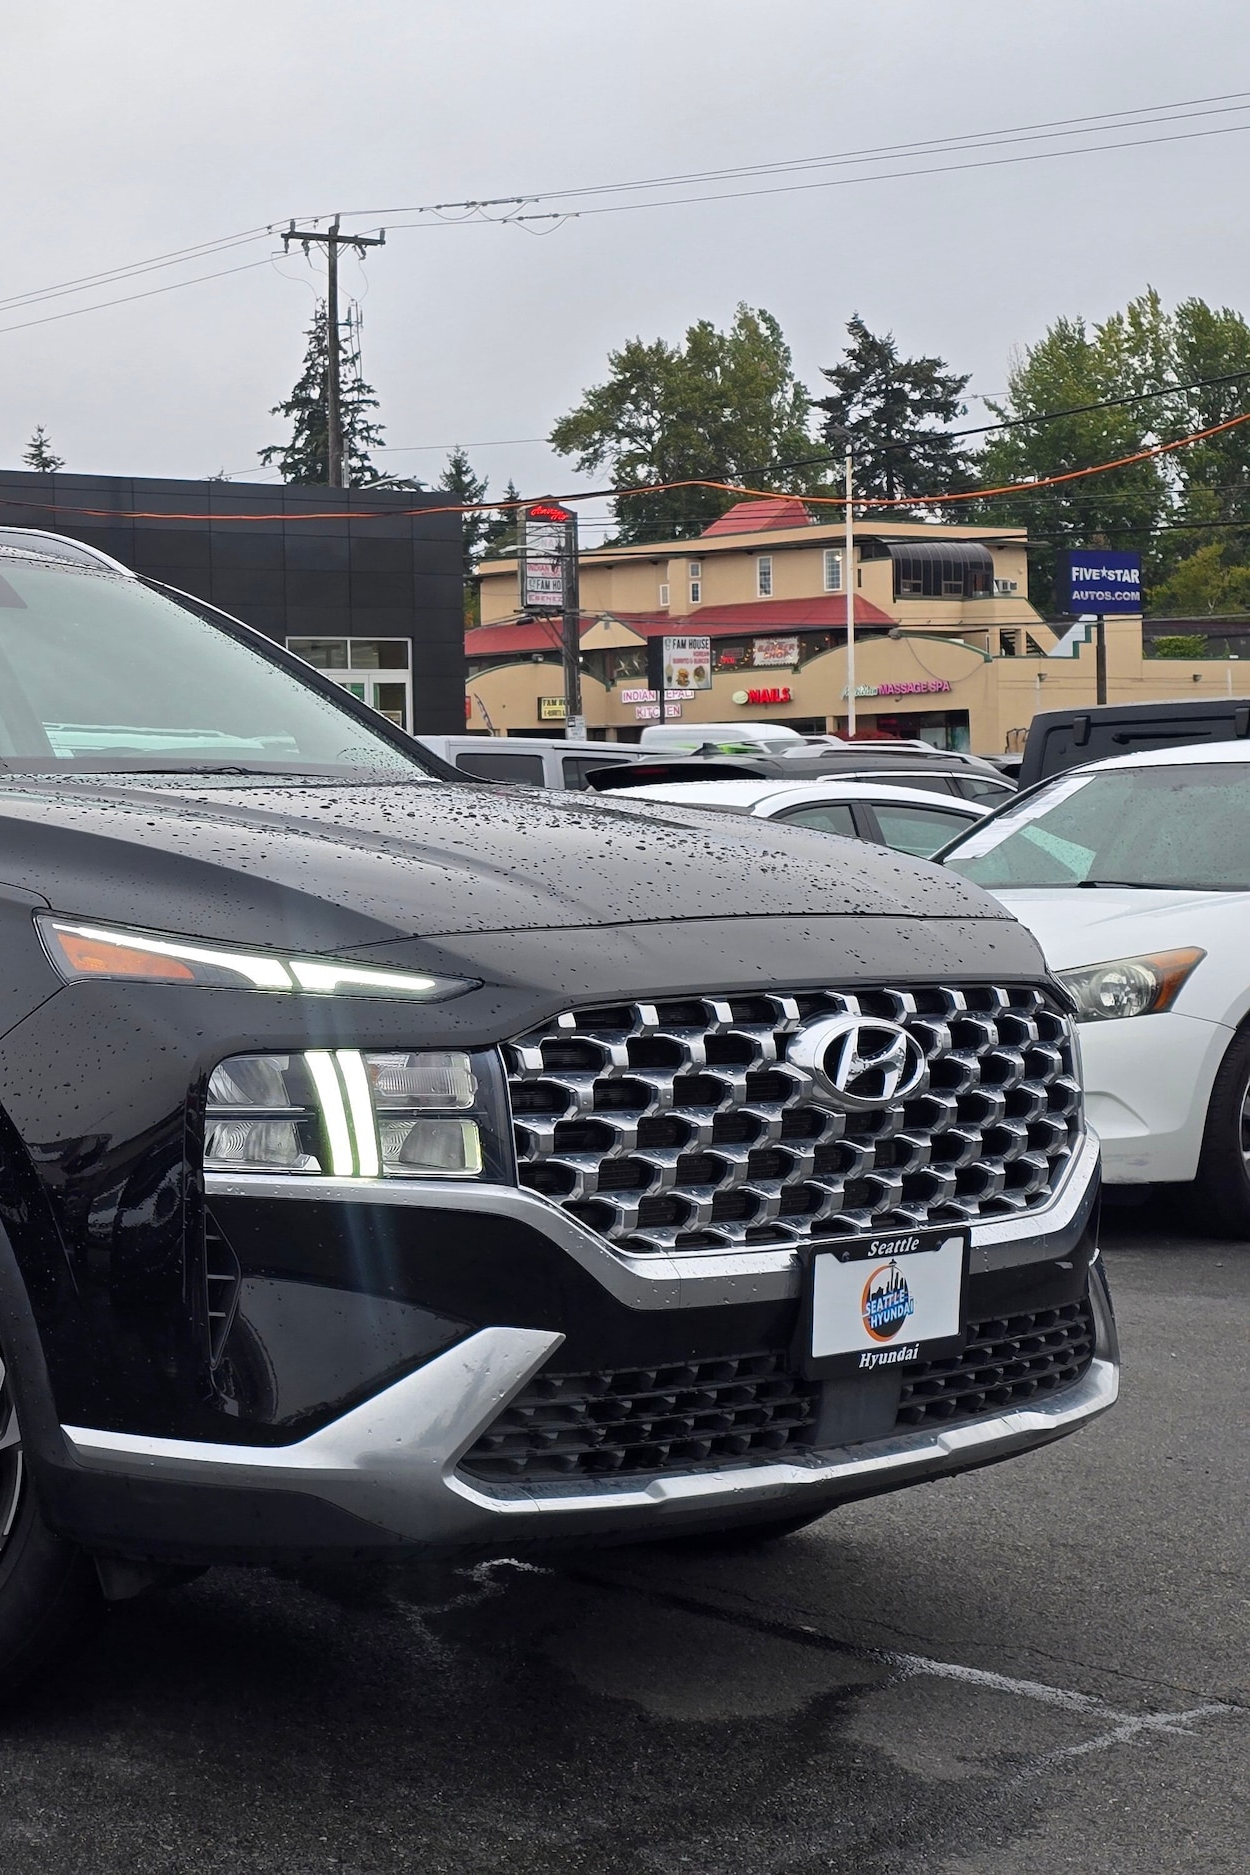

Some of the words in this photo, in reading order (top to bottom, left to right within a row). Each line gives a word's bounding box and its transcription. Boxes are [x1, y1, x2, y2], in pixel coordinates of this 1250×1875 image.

[1071, 566, 1101, 582] FIVE
[1107, 569, 1140, 584] STAR
[536, 580, 551, 590] FAM
[1072, 591, 1141, 601] AUTOS.COM
[672, 639, 687, 649] FAM
[688, 639, 709, 649] HOUSE
[623, 690, 656, 701] INDIAN
[748, 687, 791, 704] NAILS
[878, 682, 928, 695] MASSAGE
[928, 680, 950, 692] SPA
[636, 706, 681, 718] KITCEN
[867, 1236, 920, 1257] Seattle
[864, 1288, 907, 1316] SEATTLE
[869, 1298, 914, 1329] HYUNDAI
[858, 1343, 920, 1370] Hyundai
